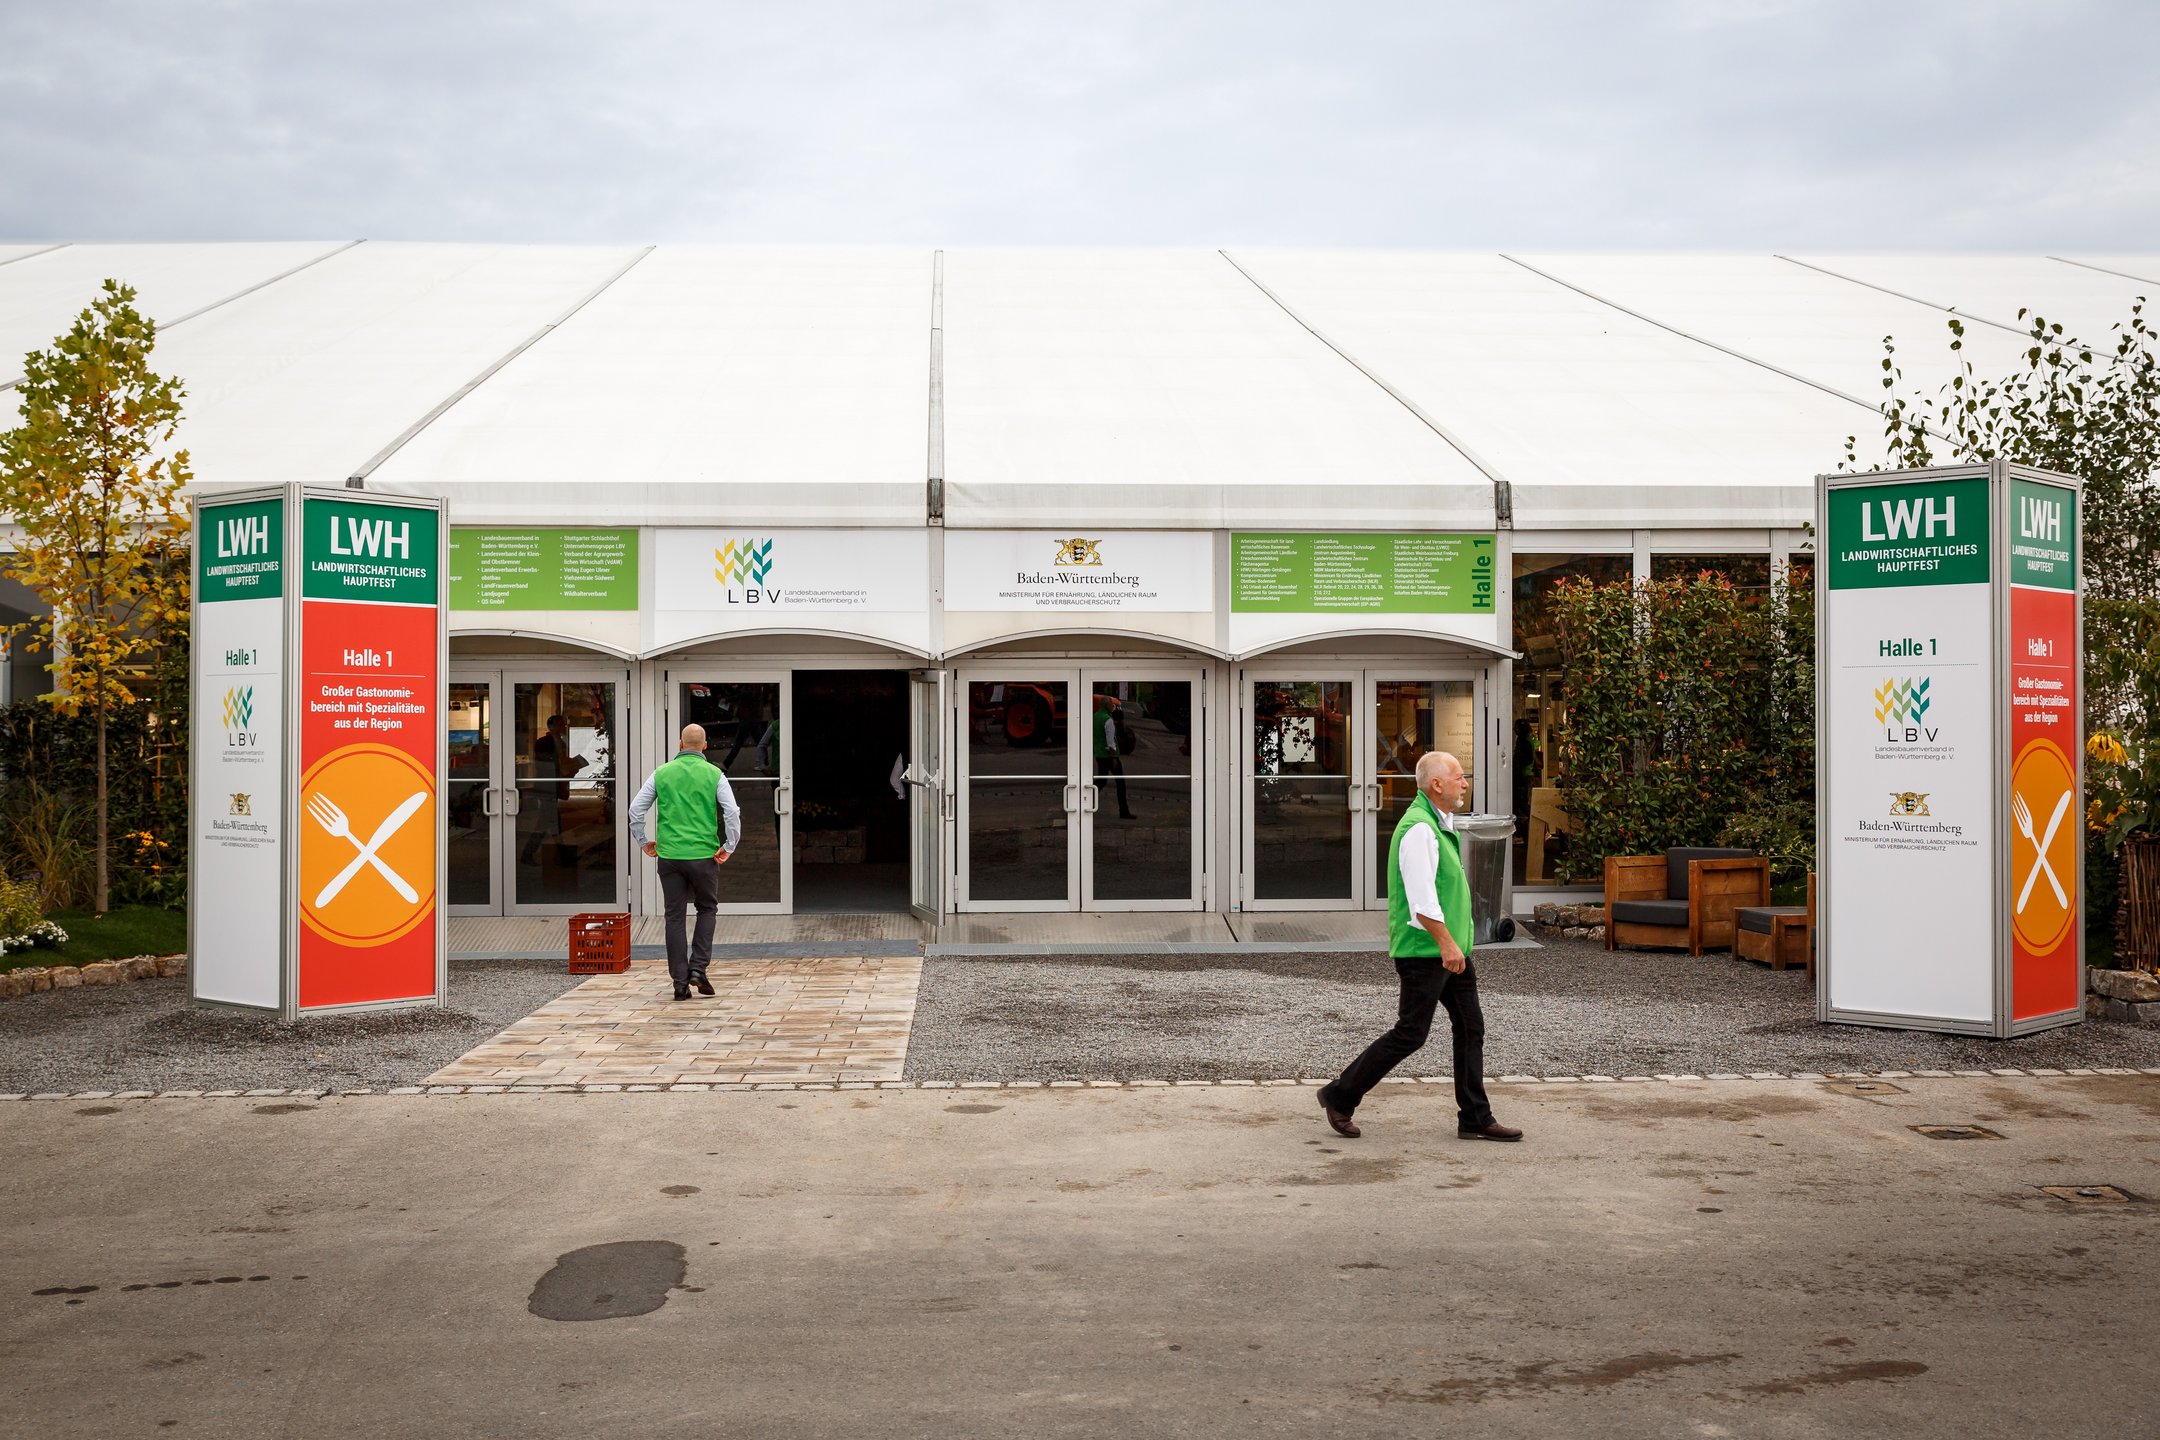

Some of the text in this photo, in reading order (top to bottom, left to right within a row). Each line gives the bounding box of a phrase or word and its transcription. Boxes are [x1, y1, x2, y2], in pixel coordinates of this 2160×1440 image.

[1862, 496, 1955, 541] LWH
[2021, 496, 2060, 542] LWH
[218, 516, 268, 558] LWH
[331, 516, 409, 560] LWH
[1841, 544, 1978, 562] LANDWIRTSCHAFTLICHES
[207, 561, 279, 577] LANDWIRTSCHAFTLICHES
[311, 561, 427, 578] LANDWIRTSCHAFTLICHES
[1471, 539, 1491, 607] Halle 1
[1877, 559, 1940, 573] HAUPTFEST
[226, 575, 259, 587] HAUPTFEST
[343, 575, 397, 589] HAUPTFEST
[1017, 572, 1139, 588] Baden-Württemberg
[1879, 638, 1937, 657] Halle 1
[2028, 638, 2053, 657] Halle 1
[226, 649, 257, 666] Halle 1
[343, 649, 393, 667] Halle 1
[321, 685, 354, 697] Großer
[310, 700, 425, 715] bereich mit Spezialitäten
[334, 717, 402, 731] aus der Region
[1859, 820, 1962, 836] Baden-Württemberg
